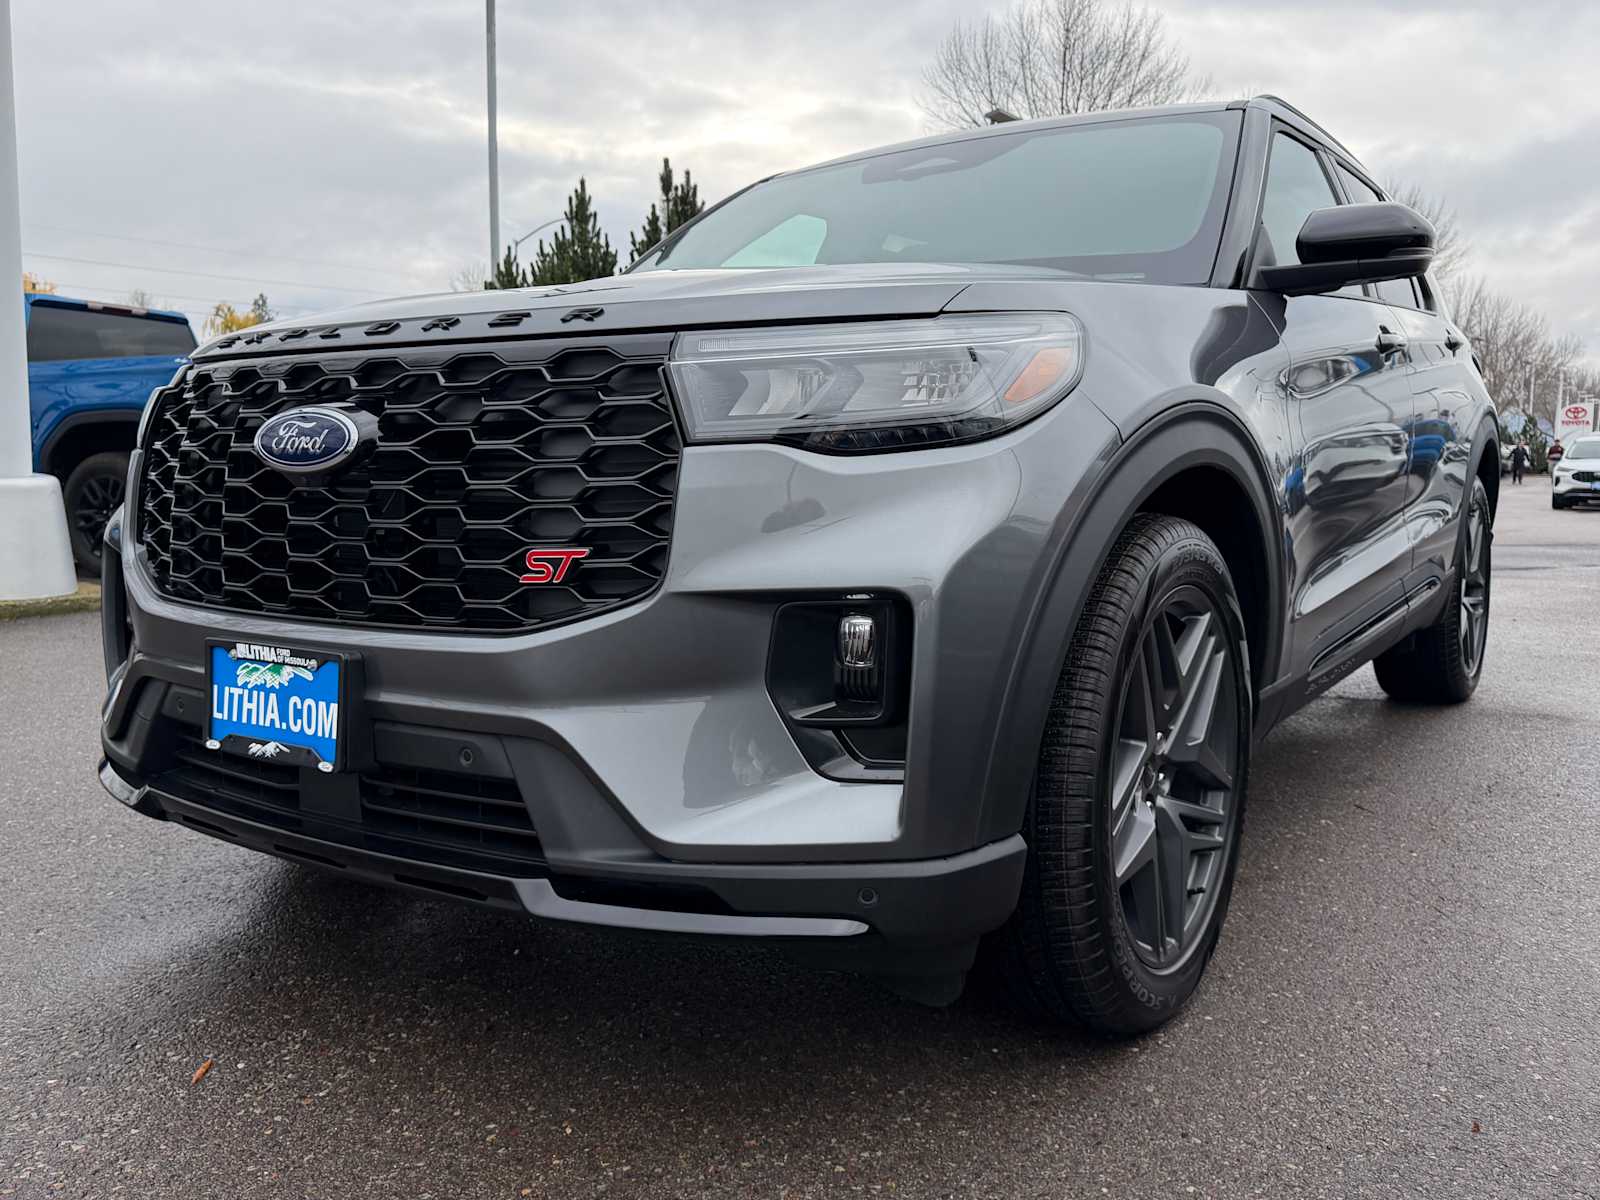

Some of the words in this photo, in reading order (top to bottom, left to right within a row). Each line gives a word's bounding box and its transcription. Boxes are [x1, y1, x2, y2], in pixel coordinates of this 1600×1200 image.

[217, 307, 605, 348] EXPLORER
[272, 421, 328, 453] Ford
[519, 549, 590, 583] ST
[246, 644, 277, 662] LITHIA
[276, 648, 290, 656] FORD
[213, 684, 338, 740] LITHIA.COM
